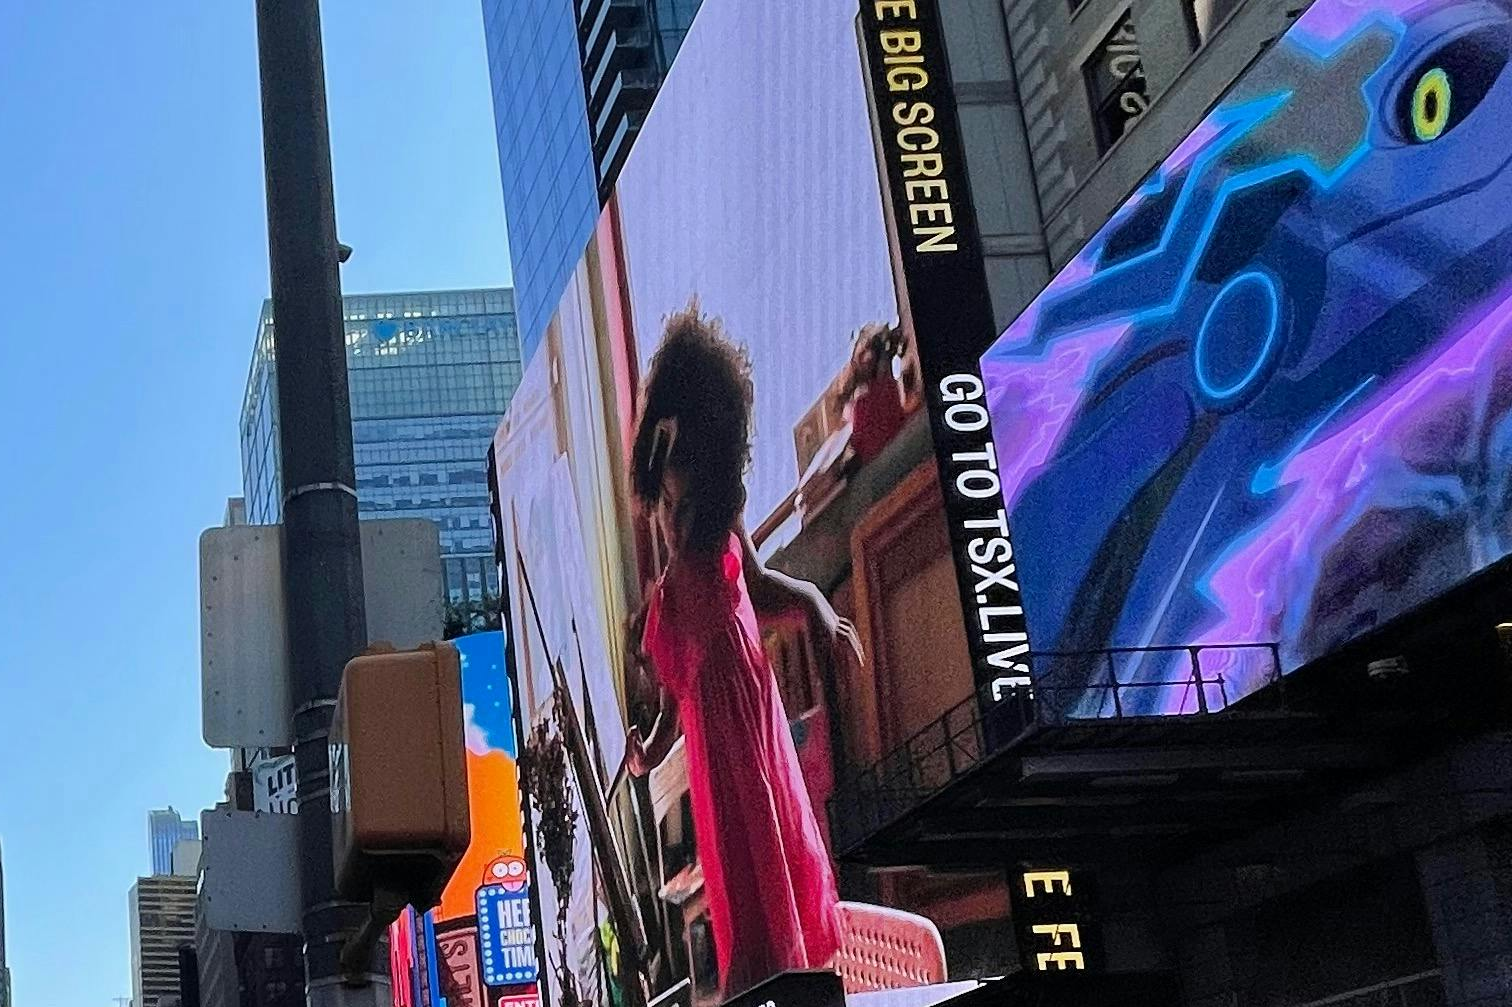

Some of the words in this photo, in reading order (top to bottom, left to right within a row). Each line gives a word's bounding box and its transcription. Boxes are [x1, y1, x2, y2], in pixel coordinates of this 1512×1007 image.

[878, 31, 929, 92] BIG
[892, 103, 958, 253] SCREEN
[939, 372, 989, 432] GO
[952, 442, 1001, 499] TO
[964, 508, 1034, 701] TSX.LIVE
